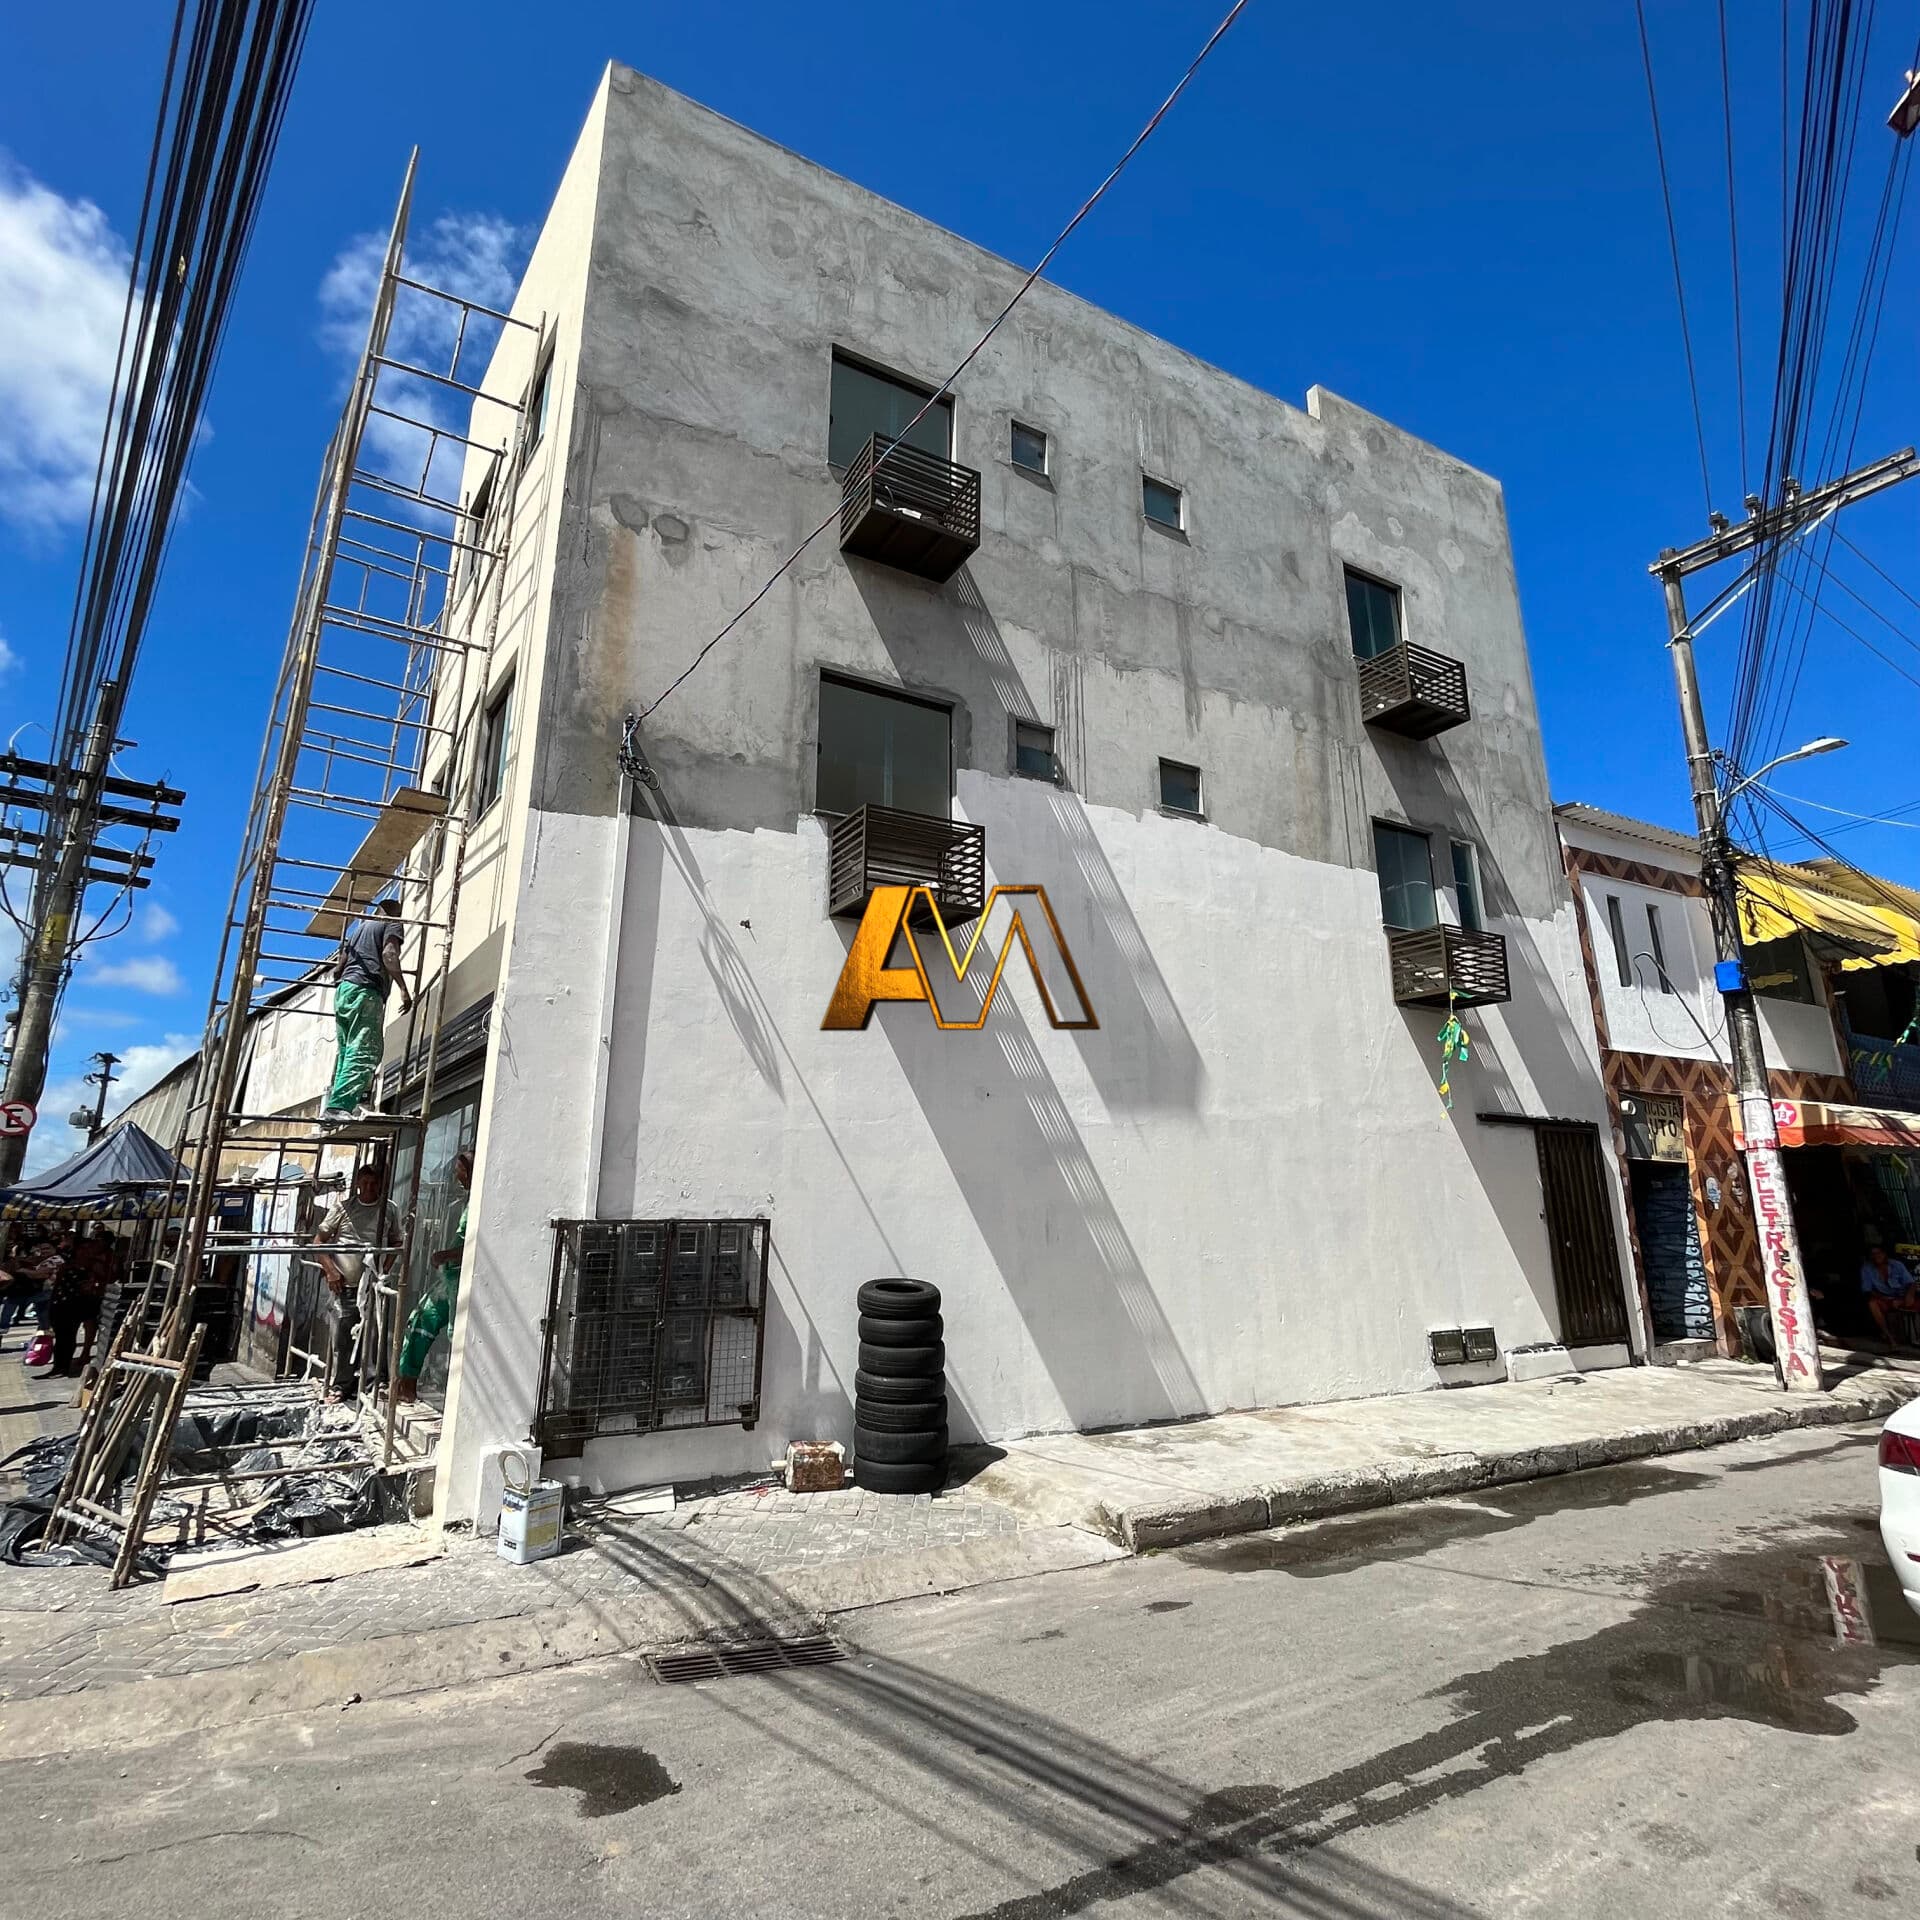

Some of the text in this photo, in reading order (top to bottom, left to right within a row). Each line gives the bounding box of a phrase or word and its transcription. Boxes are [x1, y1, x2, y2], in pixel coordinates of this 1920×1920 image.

[1646, 1101, 1680, 1118] ICISTA
[1777, 1110, 1787, 1120] 13
[6, 1108, 24, 1129] E
